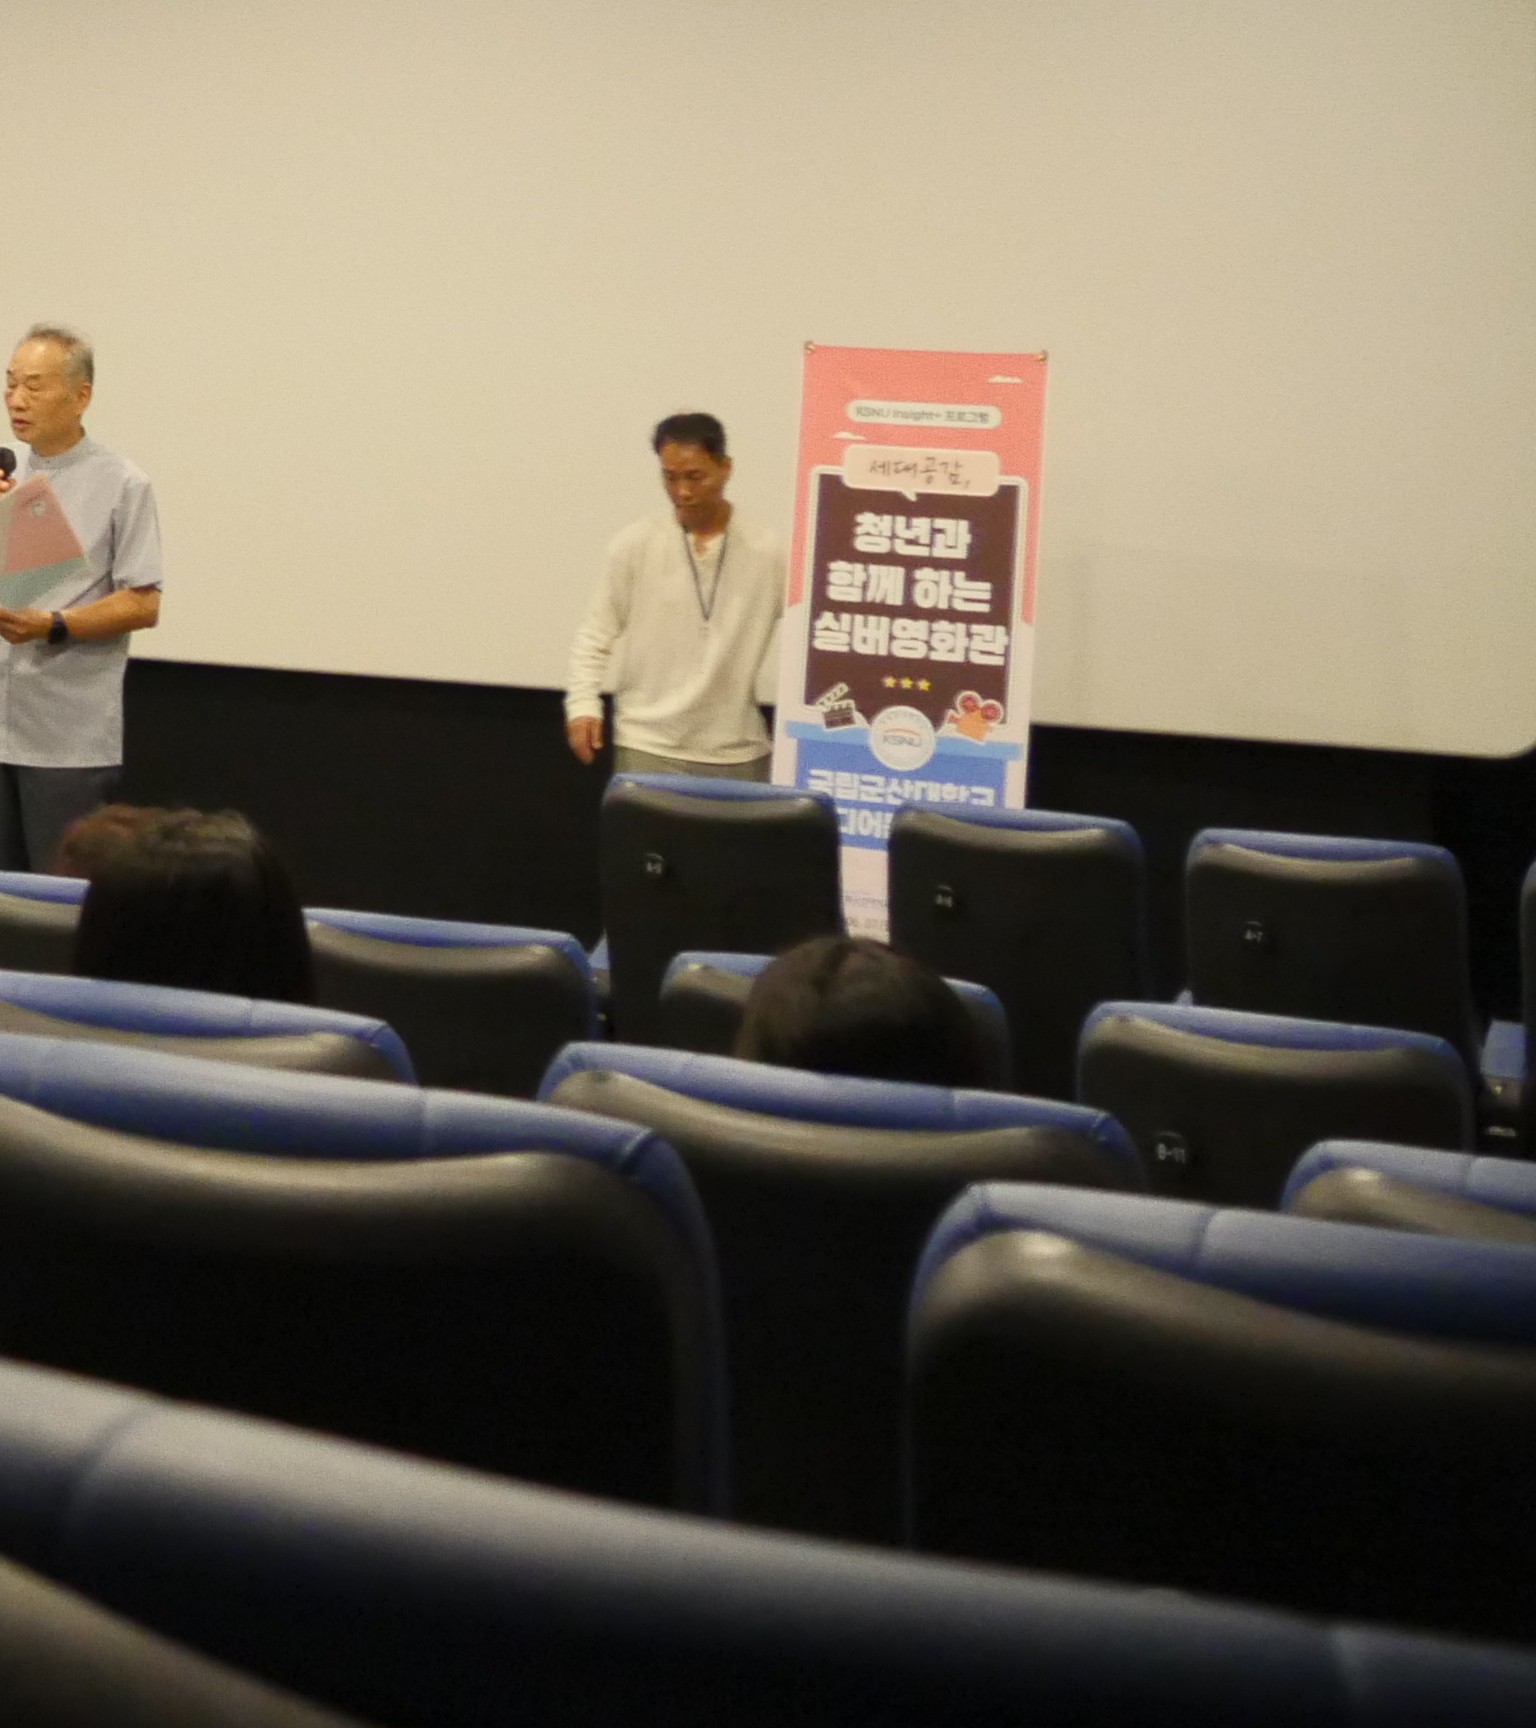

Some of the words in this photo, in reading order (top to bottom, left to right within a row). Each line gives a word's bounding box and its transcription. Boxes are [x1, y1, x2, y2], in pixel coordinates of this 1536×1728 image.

[853, 511, 972, 559] 청년과
[826, 560, 906, 606] 함께
[913, 567, 992, 613] 하는
[812, 611, 1009, 666] 실버영화관
[882, 735, 922, 747] KSNU
